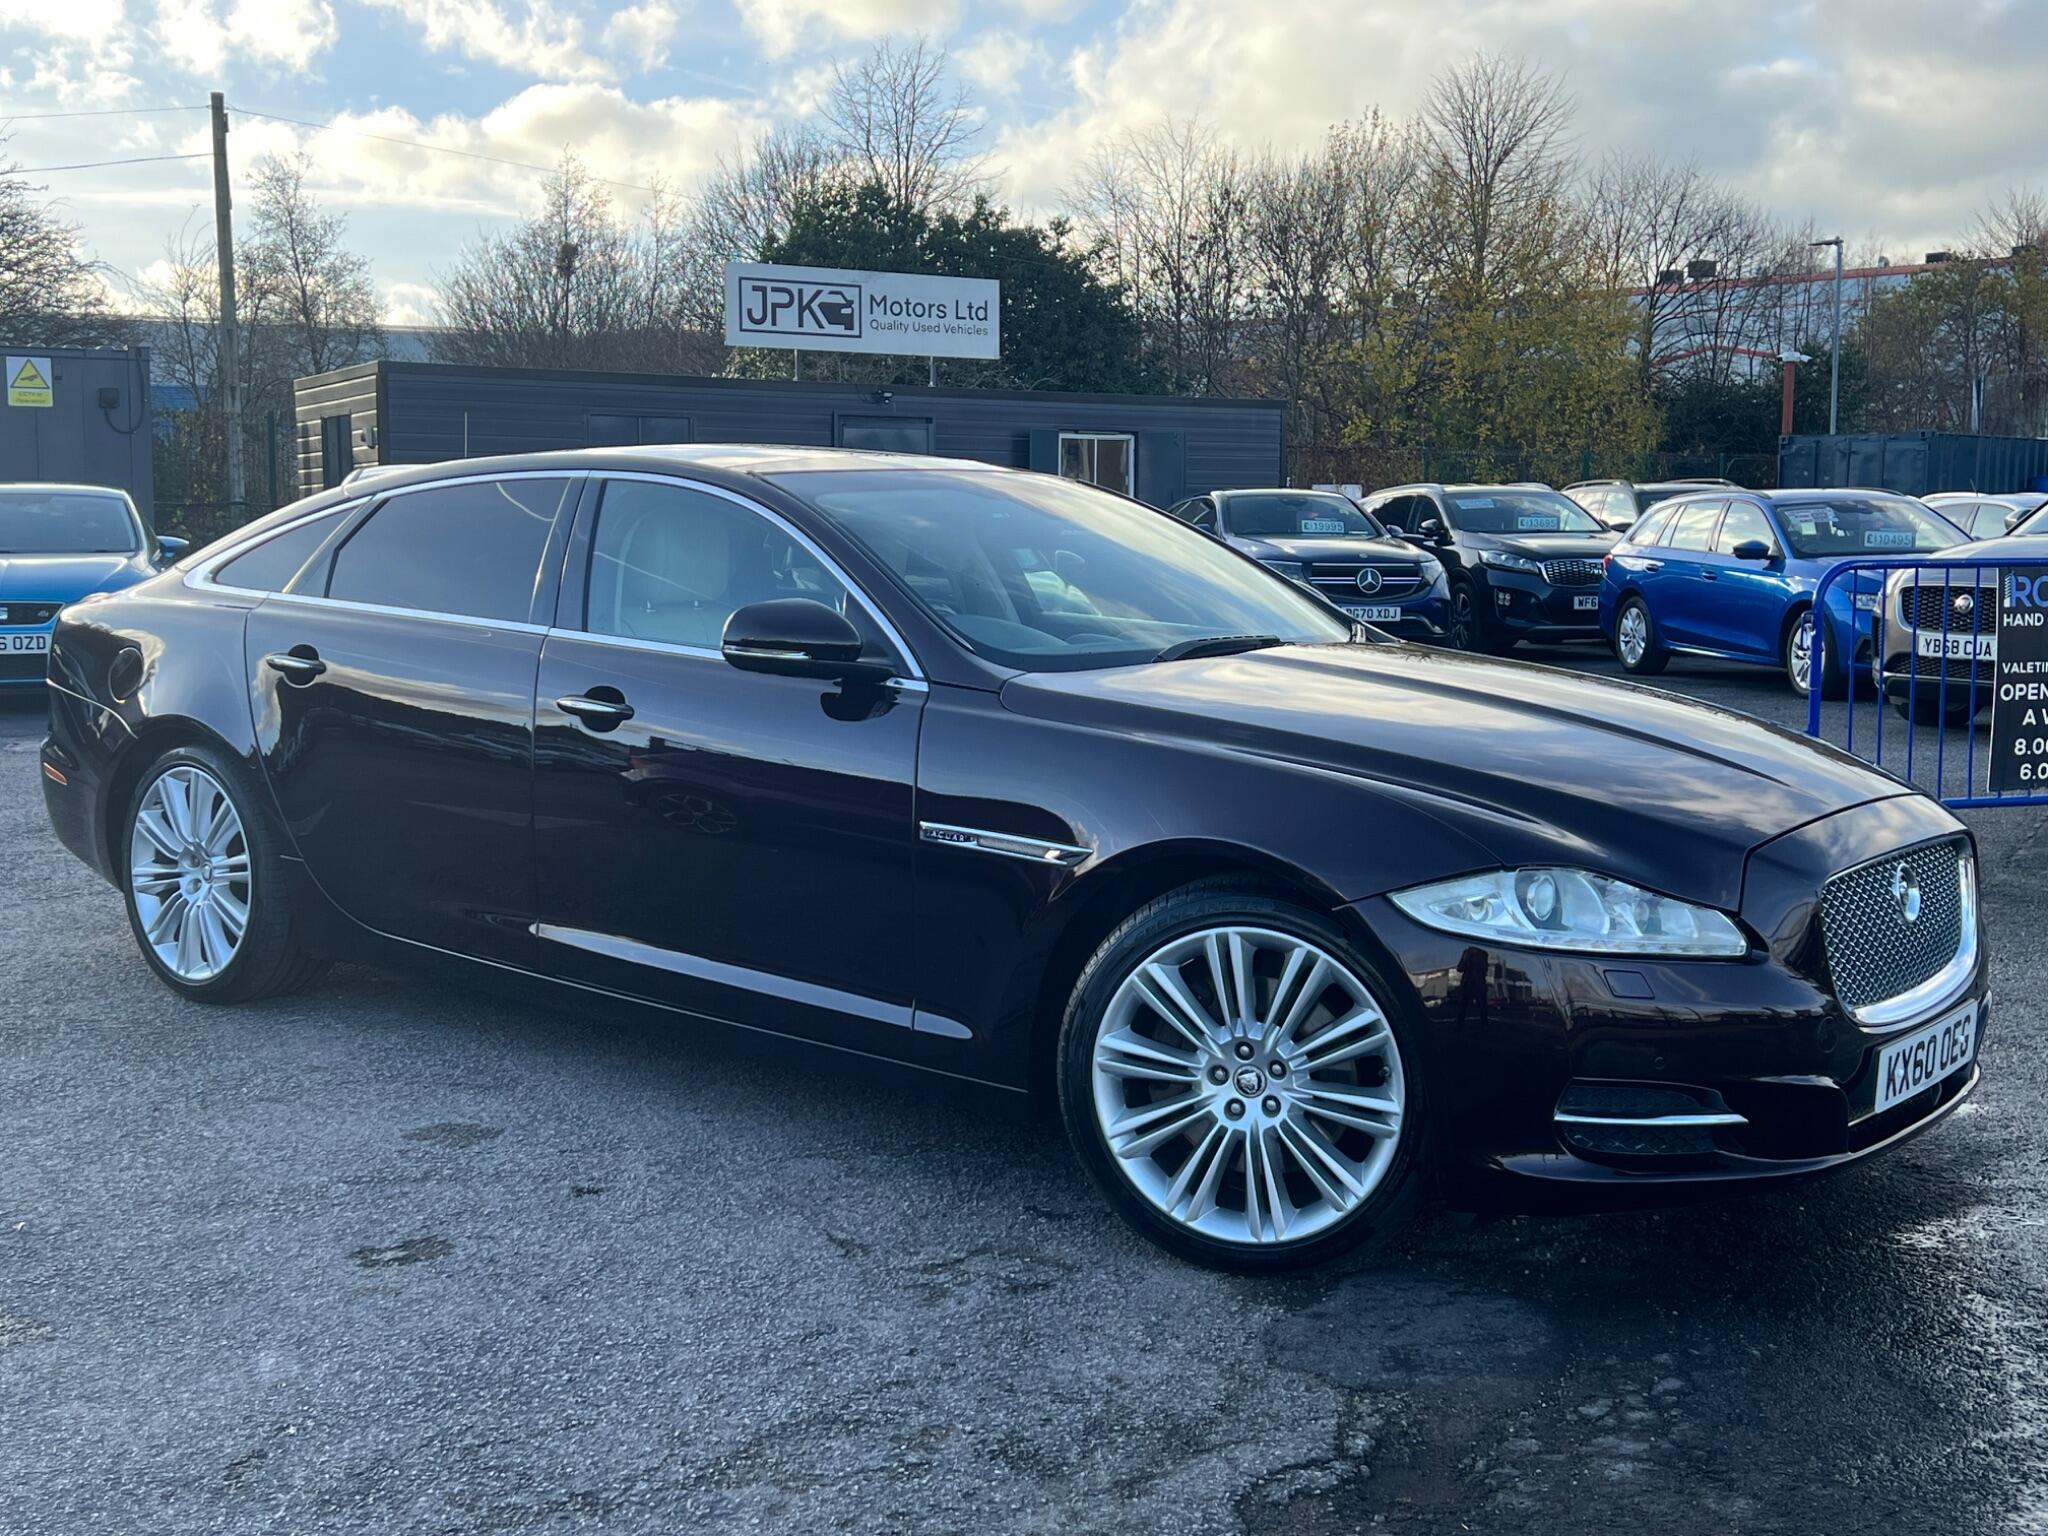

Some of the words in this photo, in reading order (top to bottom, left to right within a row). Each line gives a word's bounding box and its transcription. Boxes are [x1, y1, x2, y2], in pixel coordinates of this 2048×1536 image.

[747, 285, 825, 329] JPK
[869, 294, 947, 319] Motors
[955, 299, 989, 322] Ltd
[870, 318, 909, 333] Quality
[912, 321, 941, 334] Used
[943, 323, 989, 337] Vehicles
[1377, 608, 1397, 619] XDJ
[2003, 613, 2044, 627] HAND
[13, 636, 46, 650] OZD
[1925, 638, 1959, 654] YB68
[2022, 708, 2037, 726] A
[2014, 737, 2048, 756] 8.0
[1885, 1034, 1937, 1101] KX60
